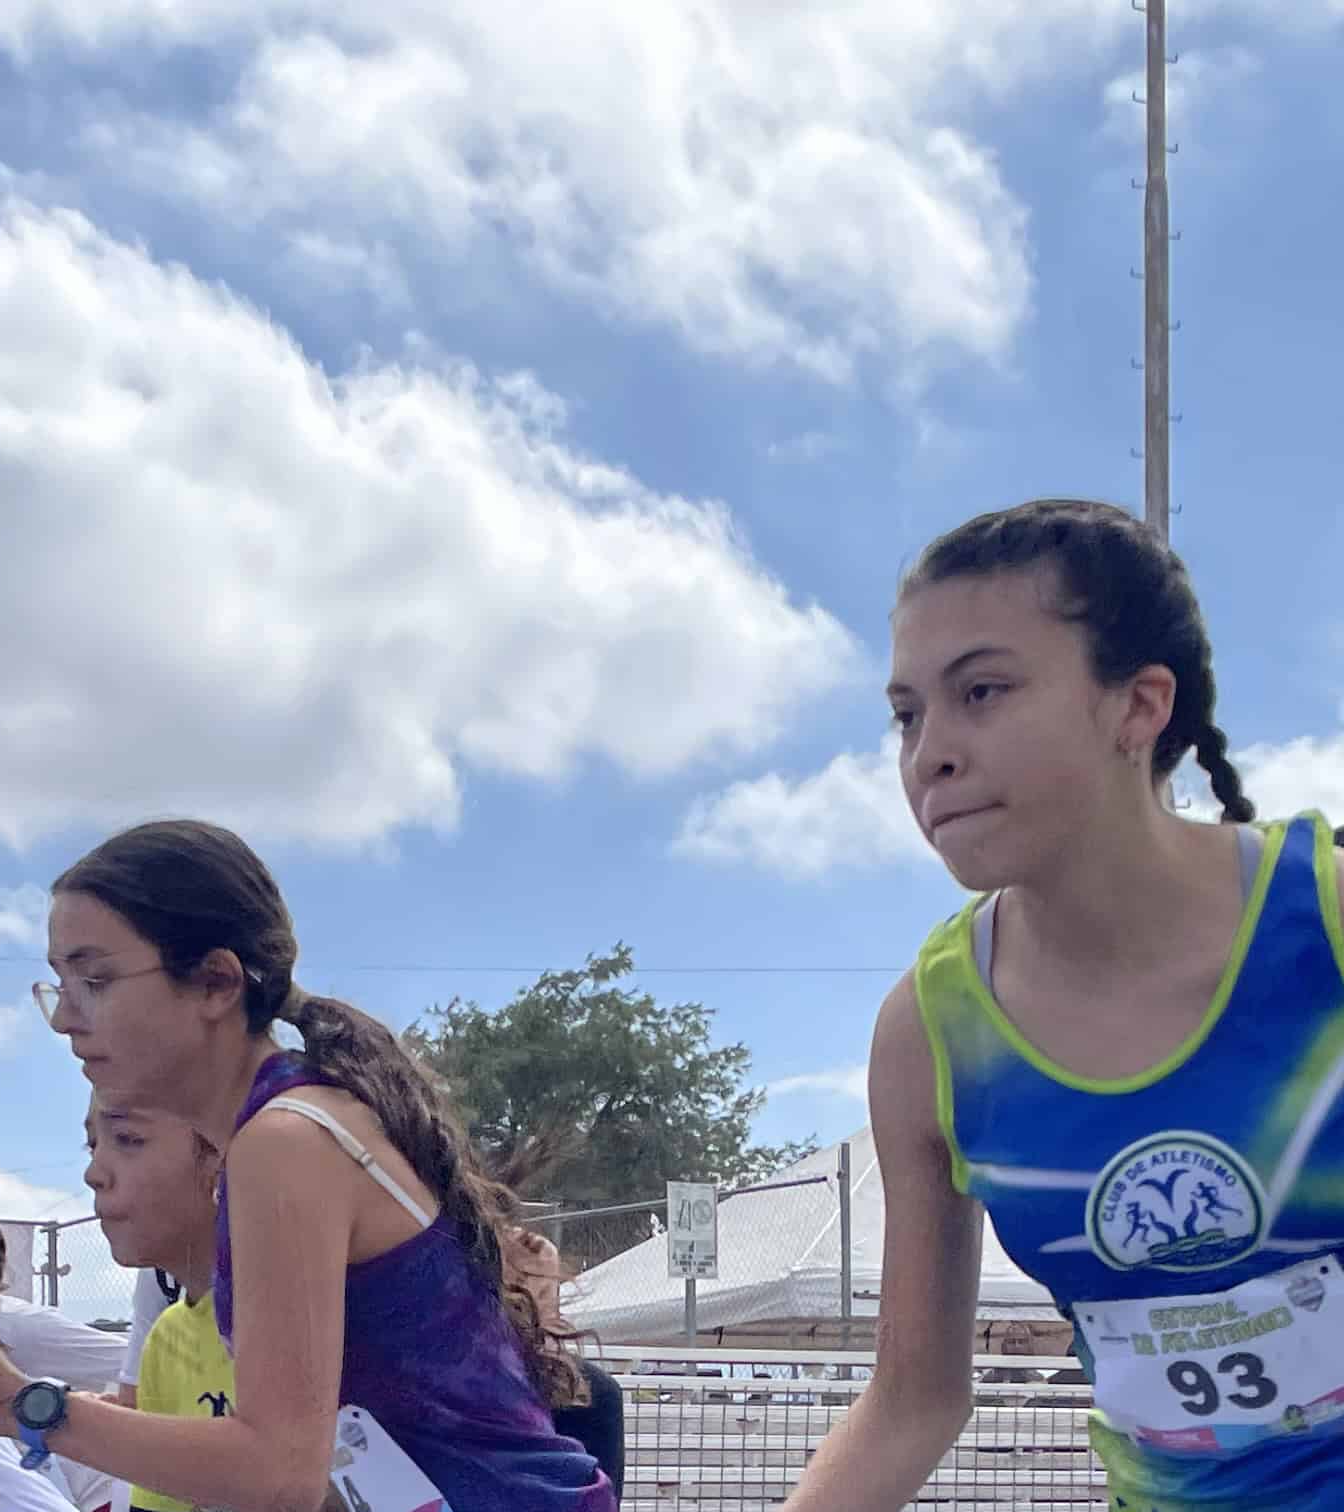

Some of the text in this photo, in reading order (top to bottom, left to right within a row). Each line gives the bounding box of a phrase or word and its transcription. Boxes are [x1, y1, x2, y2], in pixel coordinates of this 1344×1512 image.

[1102, 1150, 1237, 1222] CLUB DE ATLETISMO
[1166, 1351, 1278, 1416] 93
